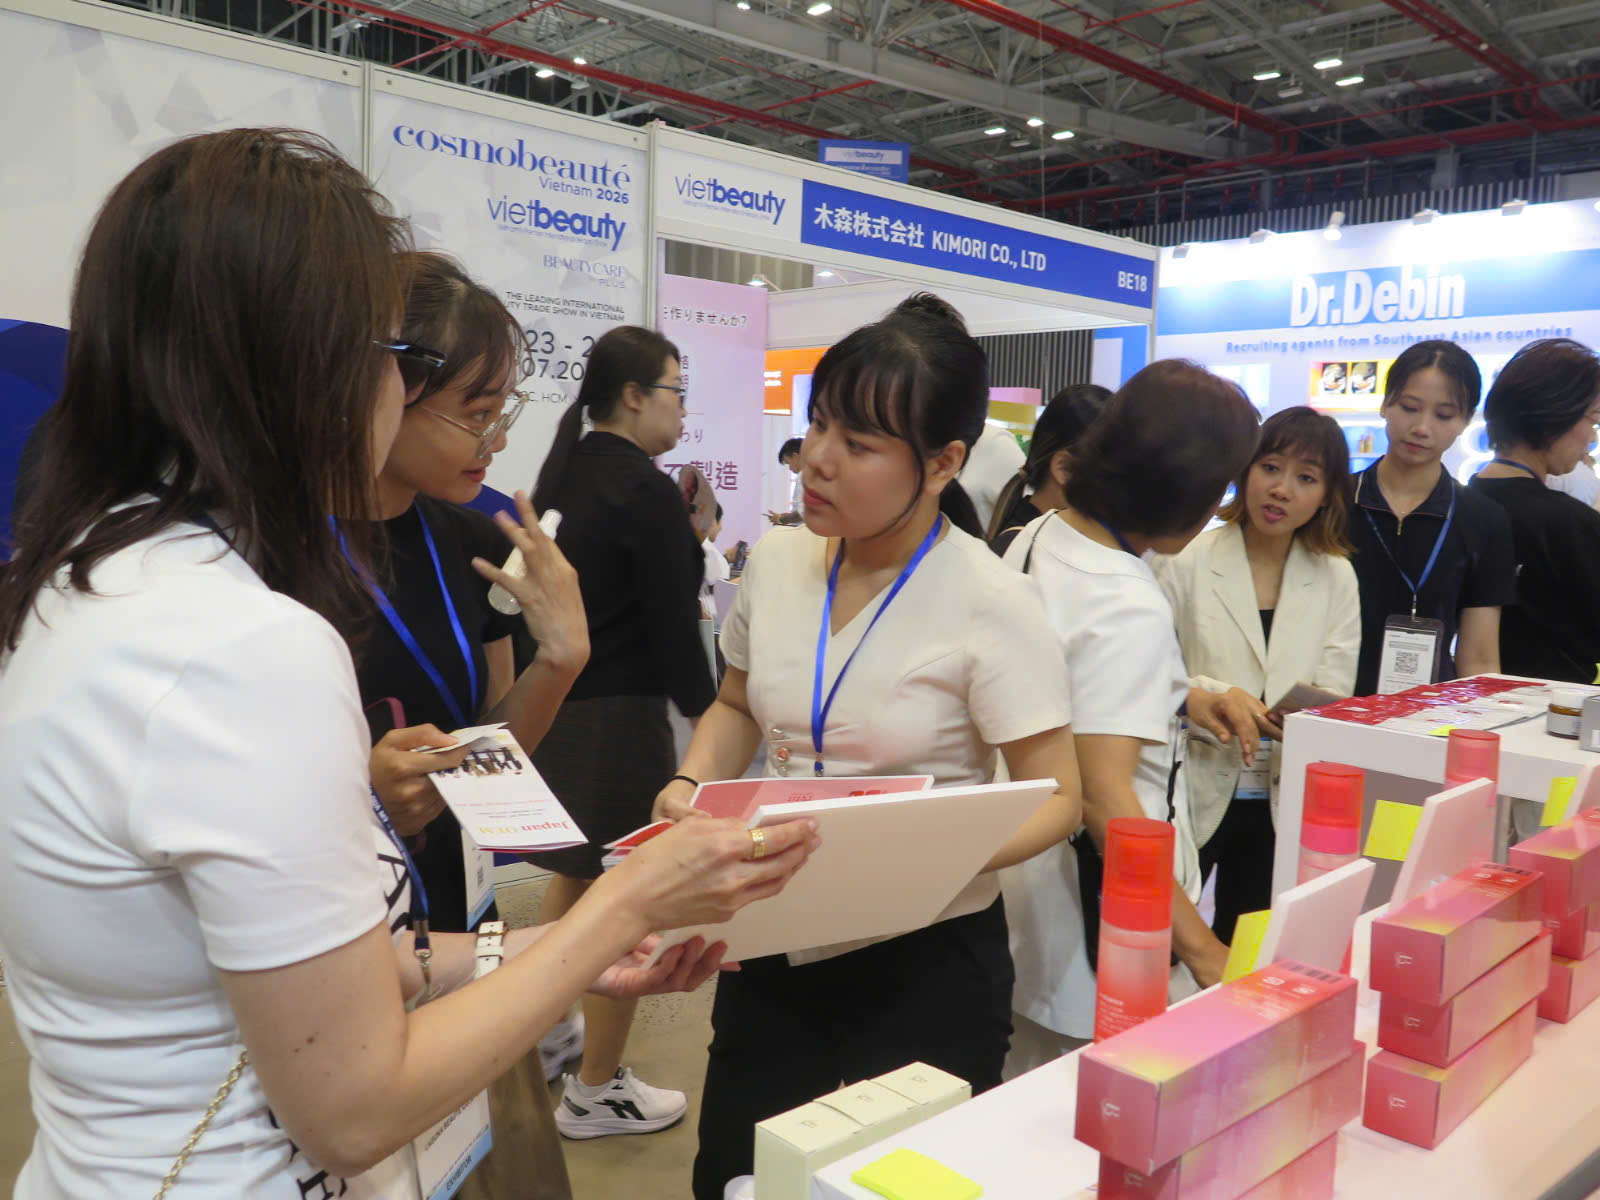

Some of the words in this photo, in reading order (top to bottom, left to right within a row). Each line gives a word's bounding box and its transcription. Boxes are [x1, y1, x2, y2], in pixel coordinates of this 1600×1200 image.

[393, 125, 631, 189] cosmobeauté
[539, 176, 593, 198] Vietnam
[596, 188, 629, 204] 2026
[675, 173, 786, 225] vietbeauty
[488, 195, 626, 251] vietbeauty
[814, 203, 925, 248] 木森株式会社
[932, 230, 986, 260] KIMORI
[990, 243, 1018, 269] CO.,
[1021, 250, 1047, 272] LTD
[1117, 270, 1148, 292] BE18
[505, 291, 523, 301] THE
[525, 294, 561, 306] LEADING
[562, 299, 625, 314] INTERNATIONAL
[1289, 264, 1466, 327] Dr.Debin
[523, 302, 550, 314] TRADE
[552, 306, 578, 317] SHOW
[590, 311, 625, 321] VIETNAM
[524, 329, 555, 354] 23
[1226, 341, 1288, 353] Recruiting
[1338, 336, 1370, 347] from
[1451, 330, 1492, 342] Asian
[1496, 326, 1573, 341] countries
